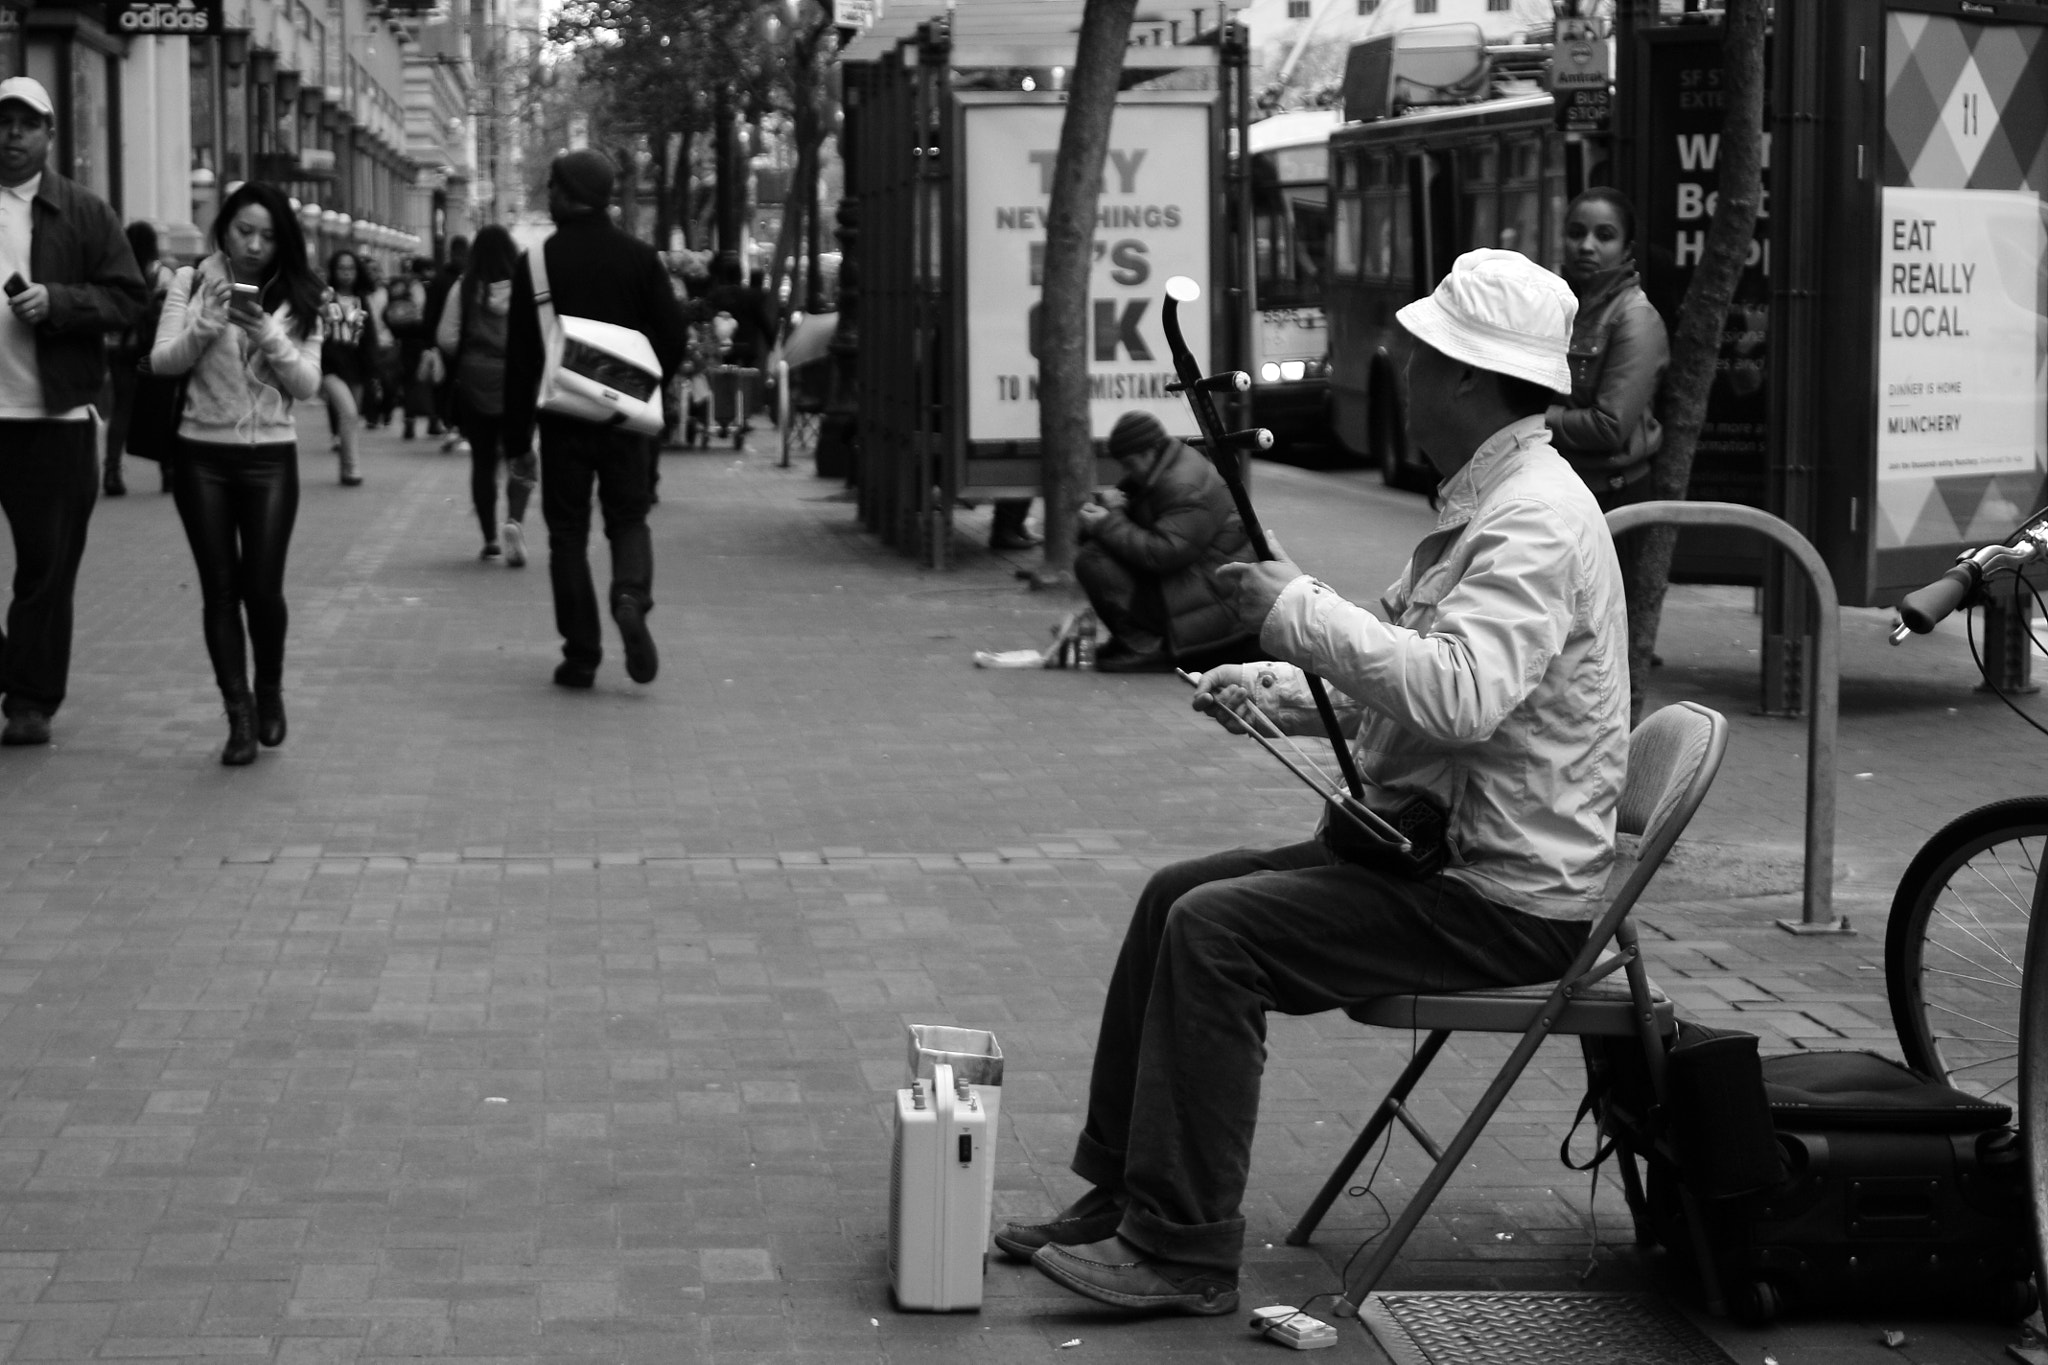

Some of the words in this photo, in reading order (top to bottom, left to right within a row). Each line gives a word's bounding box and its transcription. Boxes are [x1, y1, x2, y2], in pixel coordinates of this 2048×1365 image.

[119, 7, 209, 30] adidas
[1576, 91, 1608, 104] BUS
[1567, 106, 1609, 120] STOP
[1029, 148, 1148, 194] TY
[1096, 204, 1182, 229] HINGS
[1892, 219, 1937, 251] EAT
[1891, 262, 1977, 294] REALLY
[1890, 305, 1971, 337] LOCAL.
[998, 374, 1021, 400] TO
[1888, 382, 1924, 396] DINNER
[1927, 382, 1936, 395] IS
[1937, 381, 1962, 394] HOME
[1888, 414, 1962, 434] MUNCHERY
